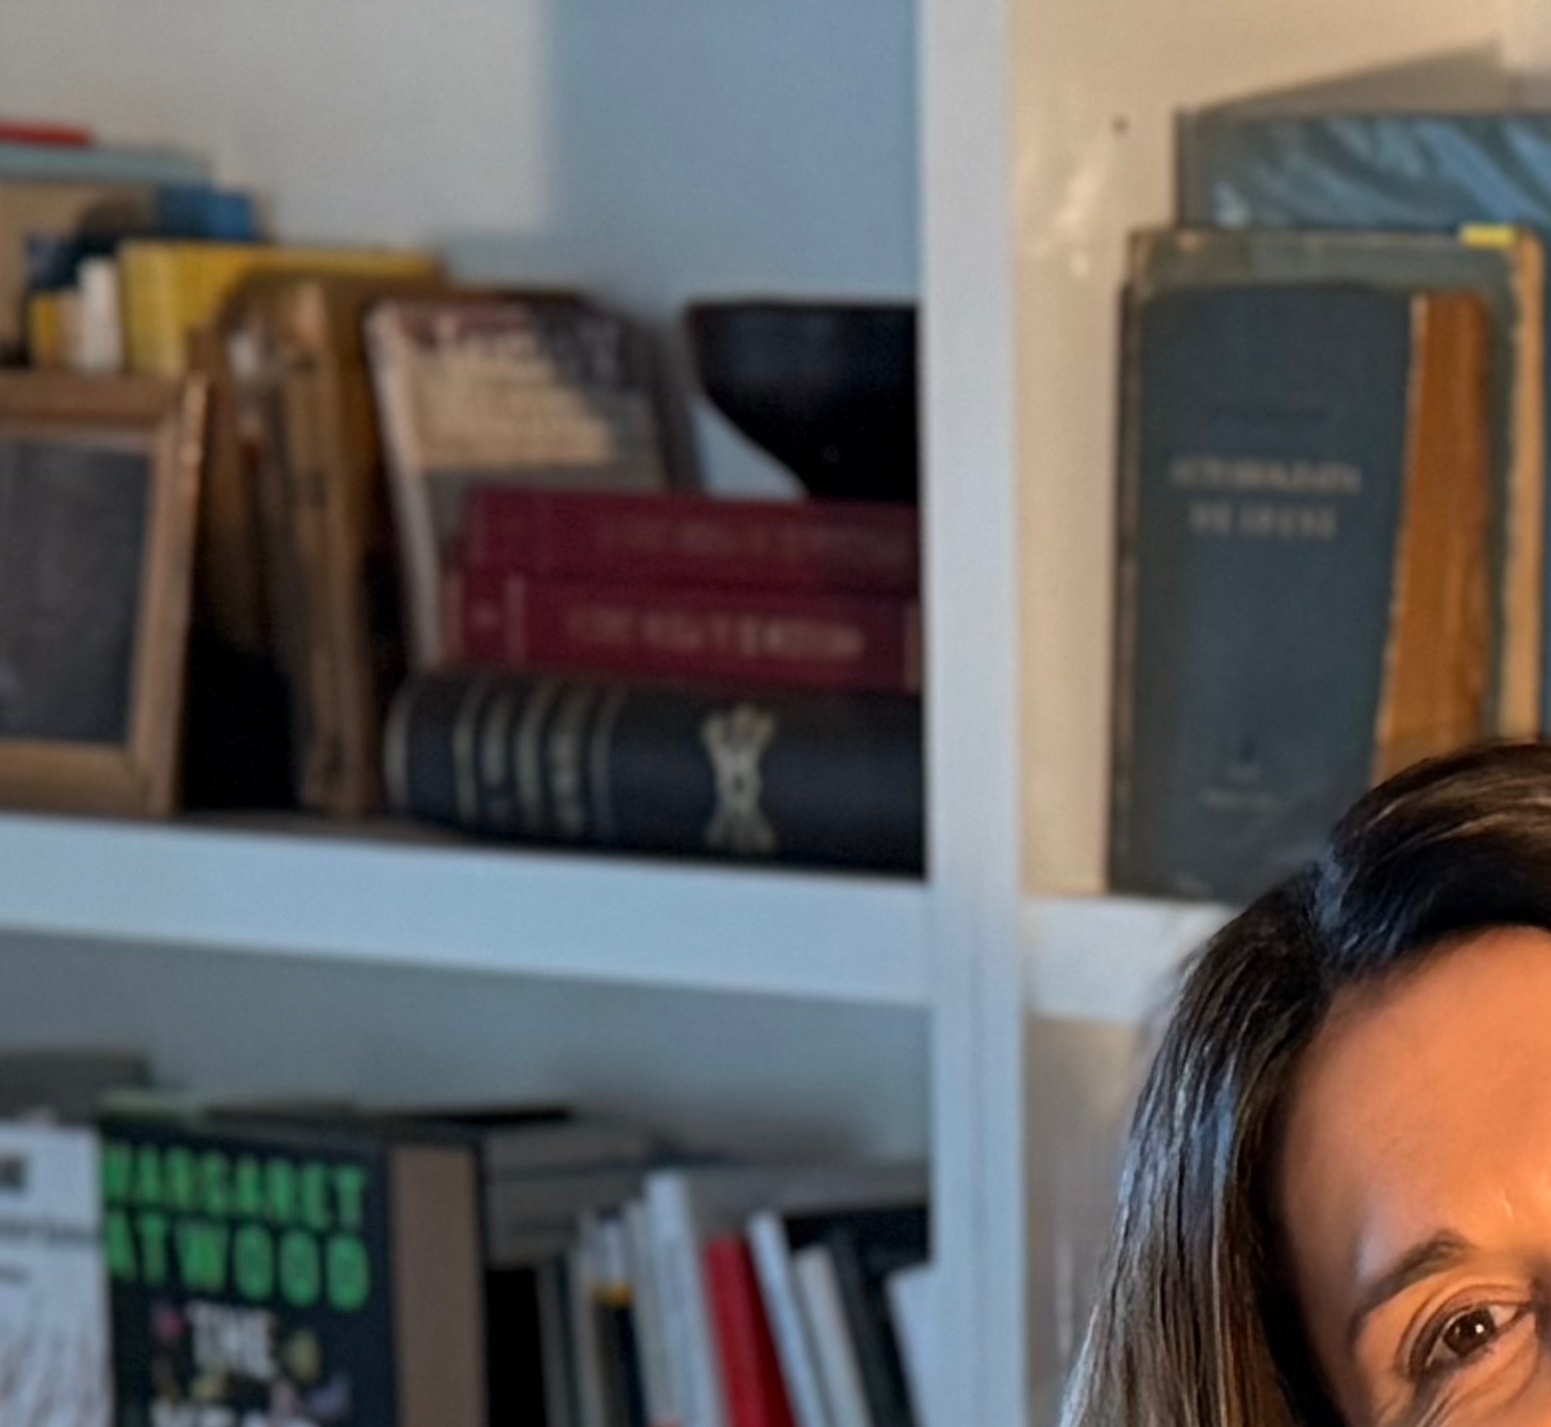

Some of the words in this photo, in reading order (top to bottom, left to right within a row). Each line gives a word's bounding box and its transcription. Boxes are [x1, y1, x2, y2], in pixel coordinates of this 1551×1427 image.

[101, 1142, 369, 1232] MARGARET
[104, 1208, 371, 1313] ATWOOD
[187, 1299, 279, 1382] THE
